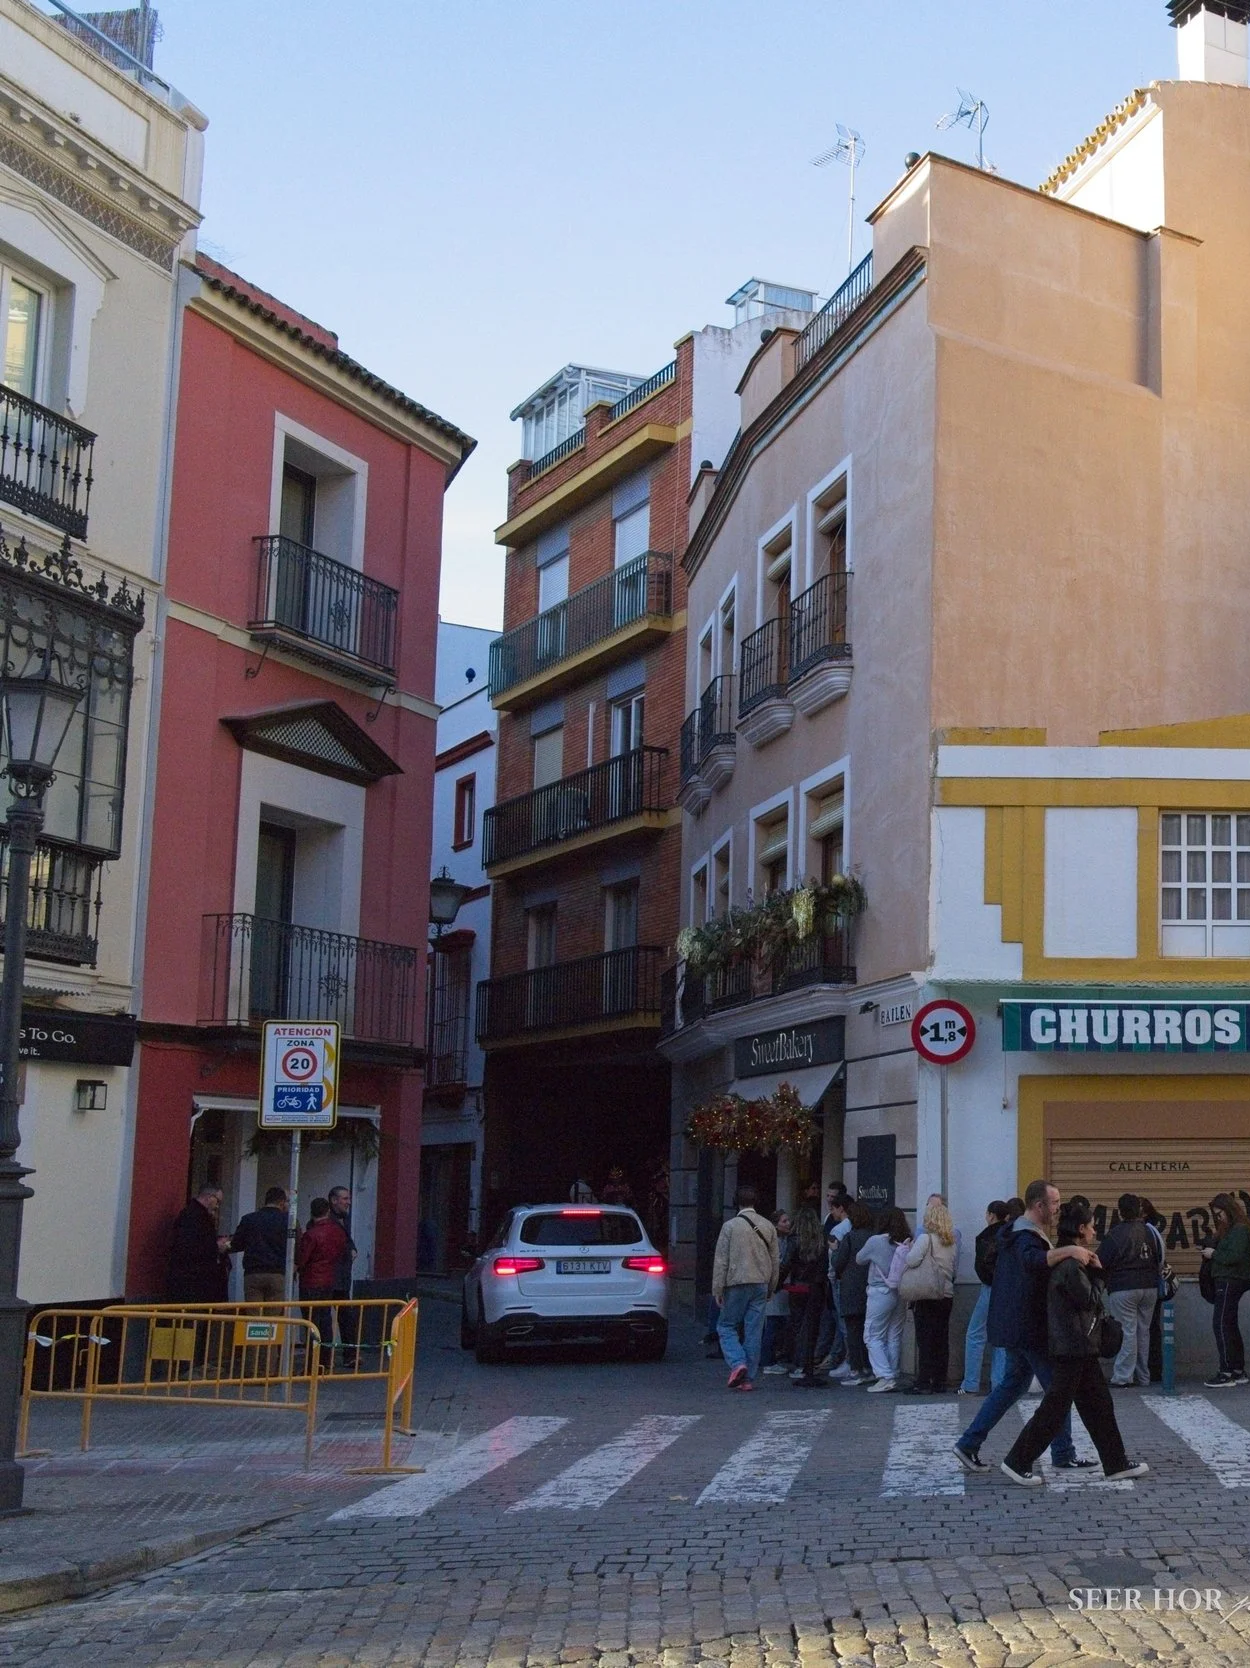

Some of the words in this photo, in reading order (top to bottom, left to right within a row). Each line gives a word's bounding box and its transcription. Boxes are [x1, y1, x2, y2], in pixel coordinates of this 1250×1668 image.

[274, 1026, 332, 1036] ATENCIÓN
[1029, 1008, 1241, 1045] CHURROS
[29, 1027, 48, 1041] To
[51, 1030, 77, 1044] Go.
[286, 1039, 315, 1047] ZONA
[751, 1029, 815, 1067] SweetBakery
[30, 1046, 40, 1056] it.
[290, 1058, 310, 1070] 20
[1109, 1161, 1191, 1172] CALENTERIA
[562, 1261, 587, 1271] 6131
[590, 1261, 610, 1271] KTV
